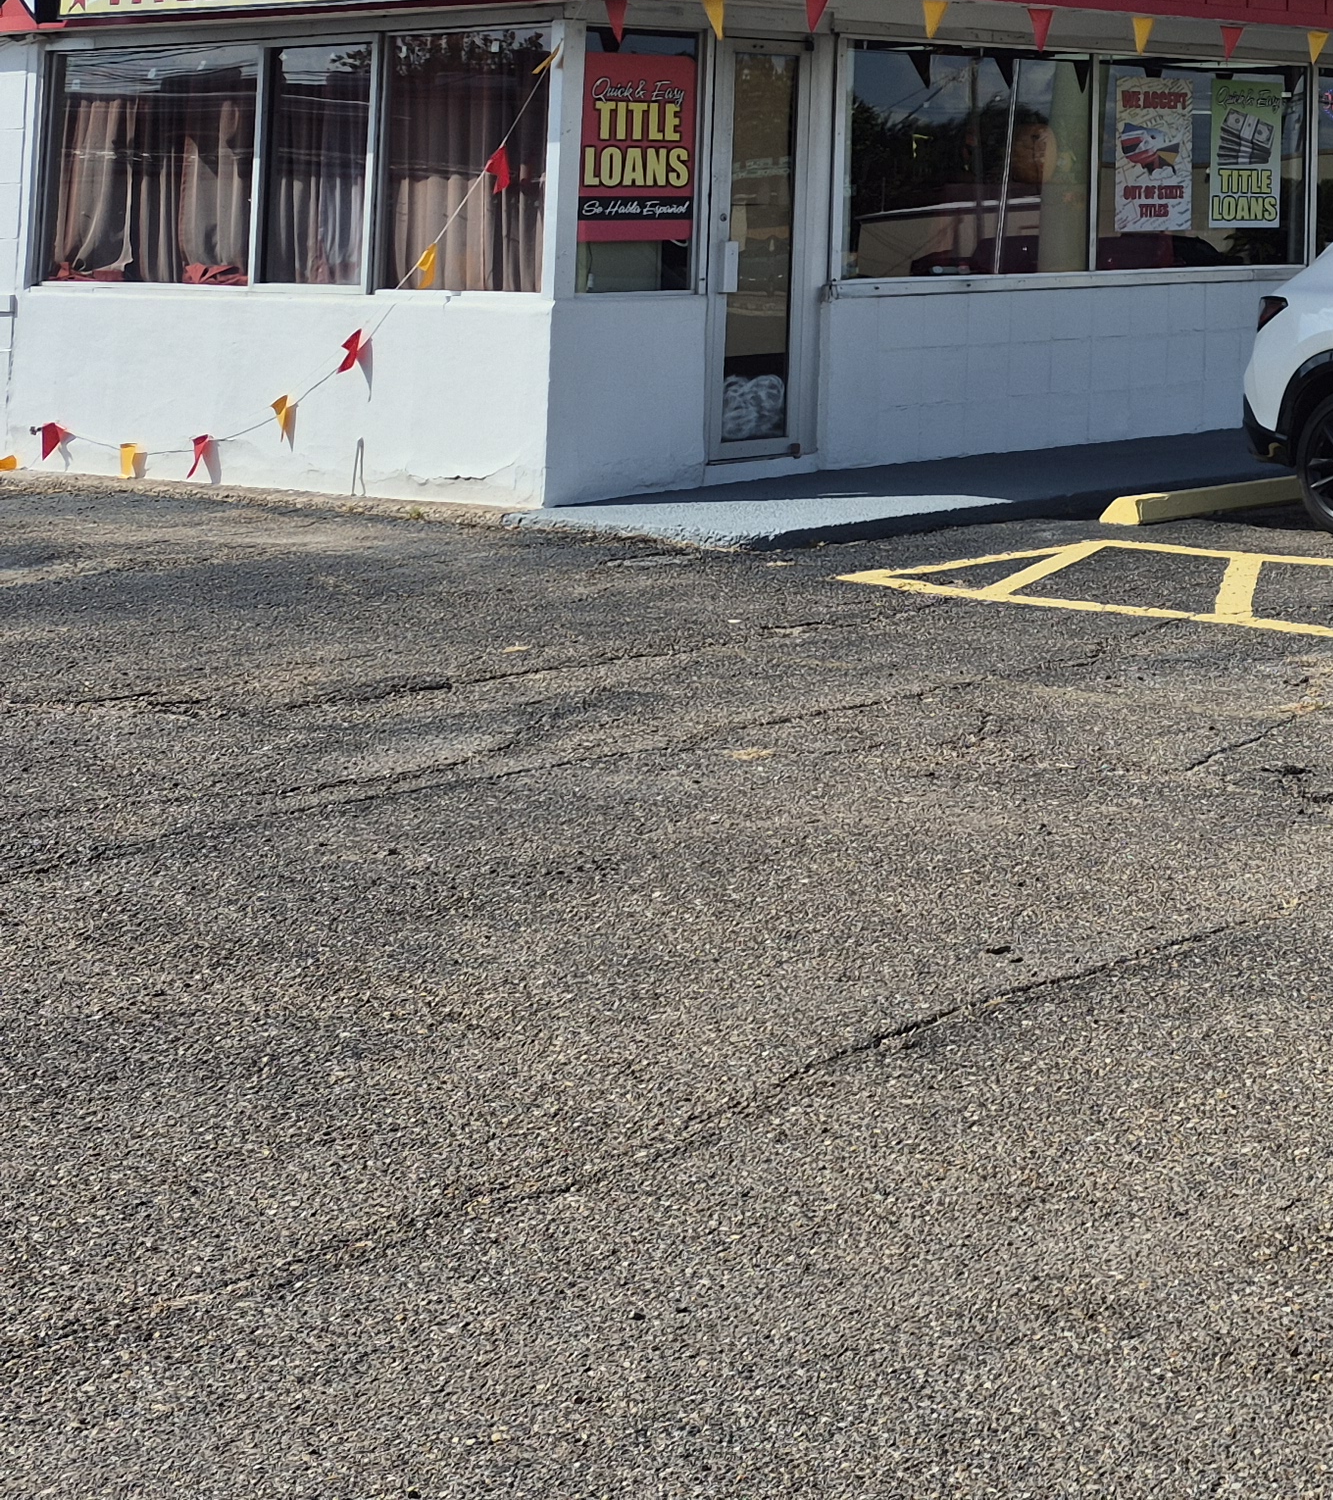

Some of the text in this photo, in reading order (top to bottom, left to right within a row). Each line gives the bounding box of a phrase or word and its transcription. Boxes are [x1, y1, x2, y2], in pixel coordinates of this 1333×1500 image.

[592, 77, 685, 106] Quick & Easy
[1121, 91, 1188, 110] WE ACCEPT
[595, 101, 681, 141] TITLE
[583, 146, 690, 187] LOANS
[1219, 169, 1272, 193] TITLE
[582, 200, 690, 219] Se Habla Español
[1211, 196, 1277, 221] LOANS
